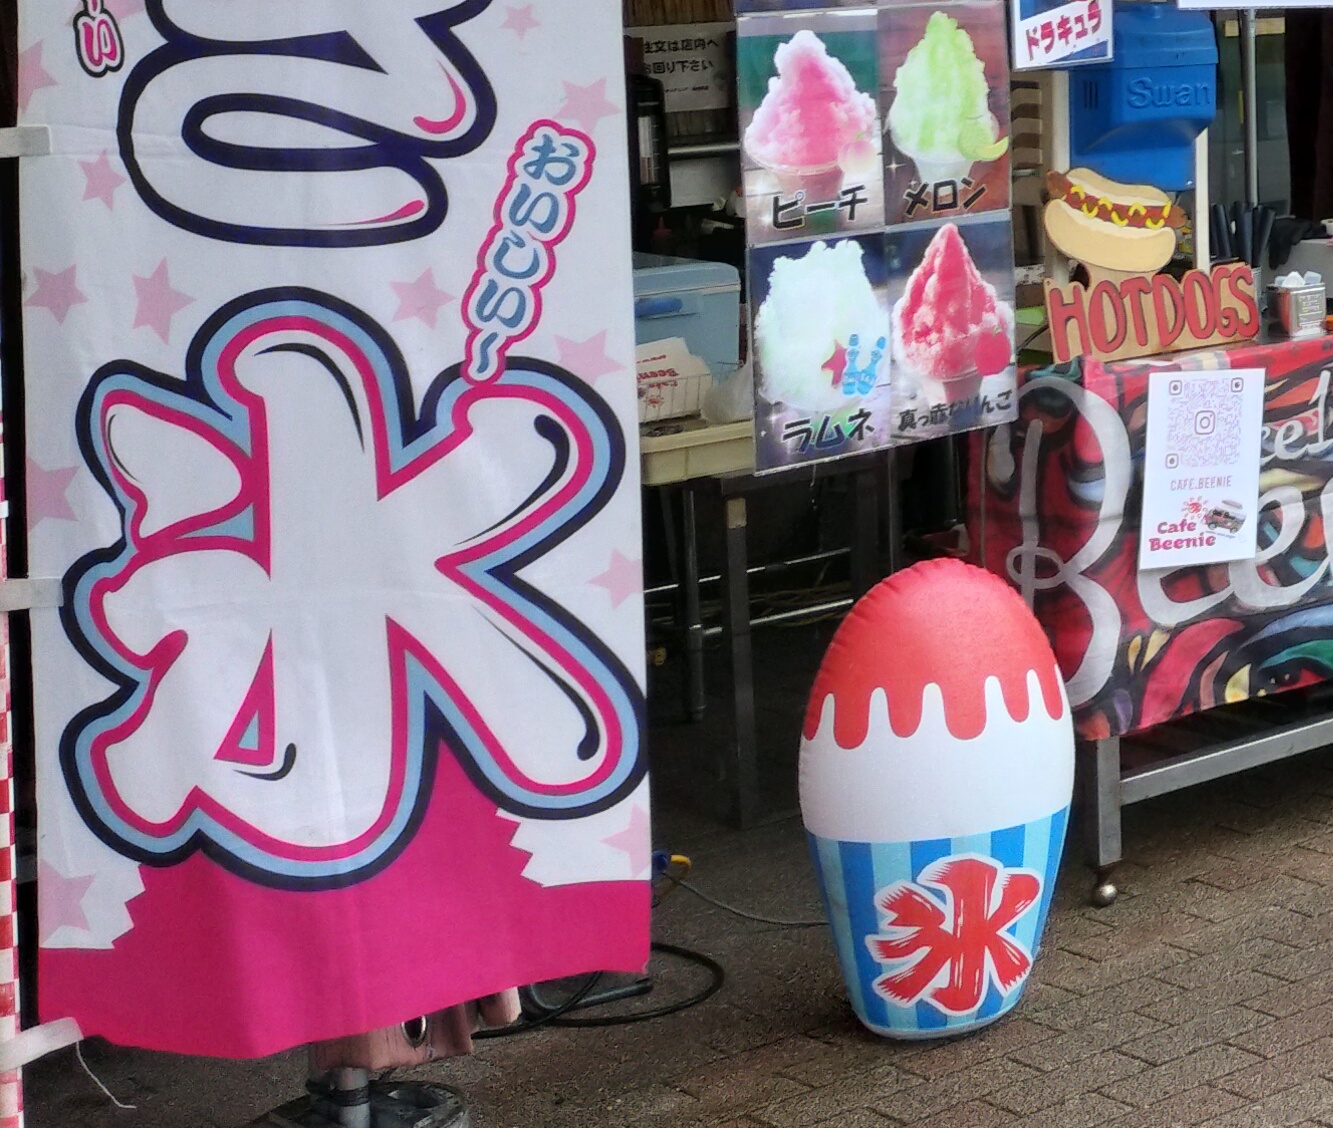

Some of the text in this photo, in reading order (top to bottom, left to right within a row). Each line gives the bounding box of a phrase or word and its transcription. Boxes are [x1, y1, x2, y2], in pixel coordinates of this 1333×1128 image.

[1025, 1, 1102, 62] ドラキュラ
[1125, 75, 1212, 111] Swan
[772, 184, 868, 230] ピーチ
[903, 176, 988, 217] メロン
[1049, 268, 1261, 363] HOTDOGS
[781, 408, 875, 453] ラムネ
[1148, 531, 1217, 552] Beenie
[1156, 518, 1197, 534] Cafe
[865, 852, 1043, 1017] 氷
